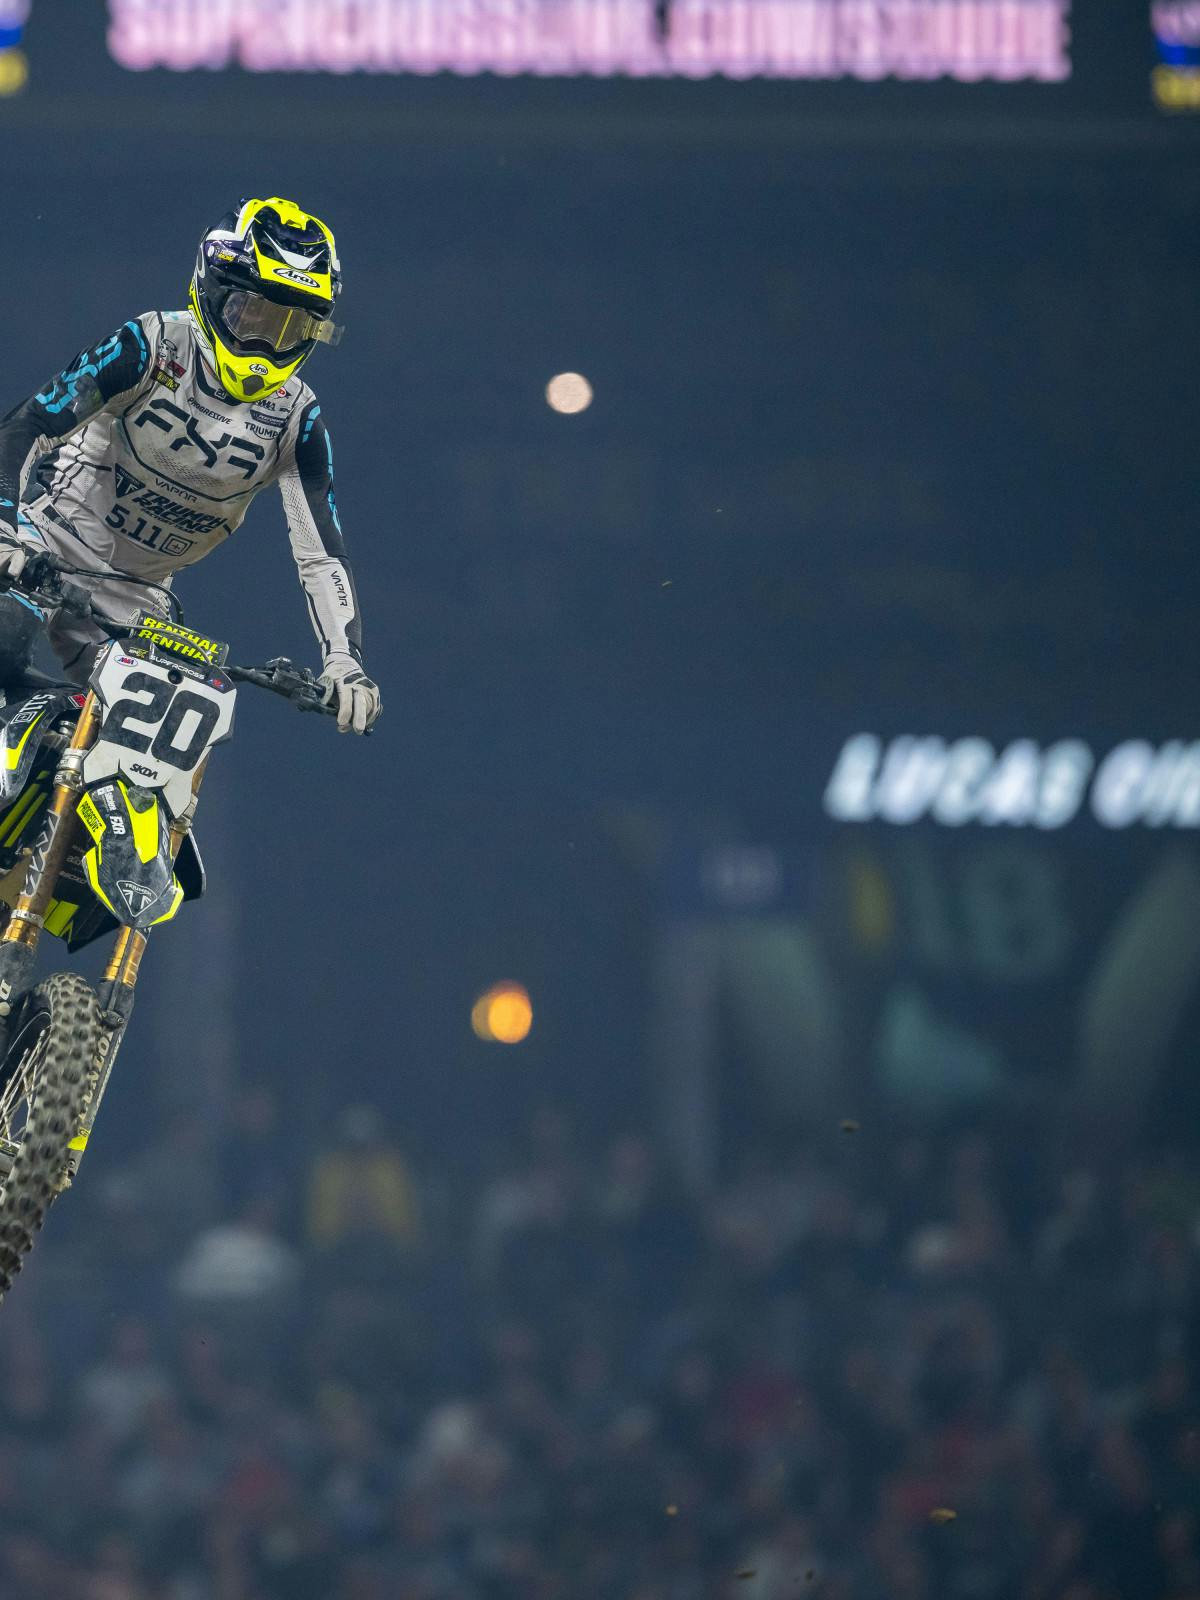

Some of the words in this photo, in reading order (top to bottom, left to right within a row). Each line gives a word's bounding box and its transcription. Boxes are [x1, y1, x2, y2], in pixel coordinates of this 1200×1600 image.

[281, 269, 314, 284] Arai
[187, 397, 233, 425] PROGRESSIVE
[244, 421, 280, 438] TRIUMP
[155, 478, 198, 503] VAPOR
[104, 504, 162, 549] 5.11
[131, 497, 213, 534] RACING
[141, 489, 227, 529] TRIUMPH
[330, 570, 348, 607] VAPOR
[138, 629, 214, 665] RENTHAL
[143, 617, 219, 654] RENTHAL
[100, 671, 221, 772] 20
[130, 763, 158, 780] SKDA
[823, 731, 1095, 829] LUCAS
[109, 815, 126, 835] FXR
